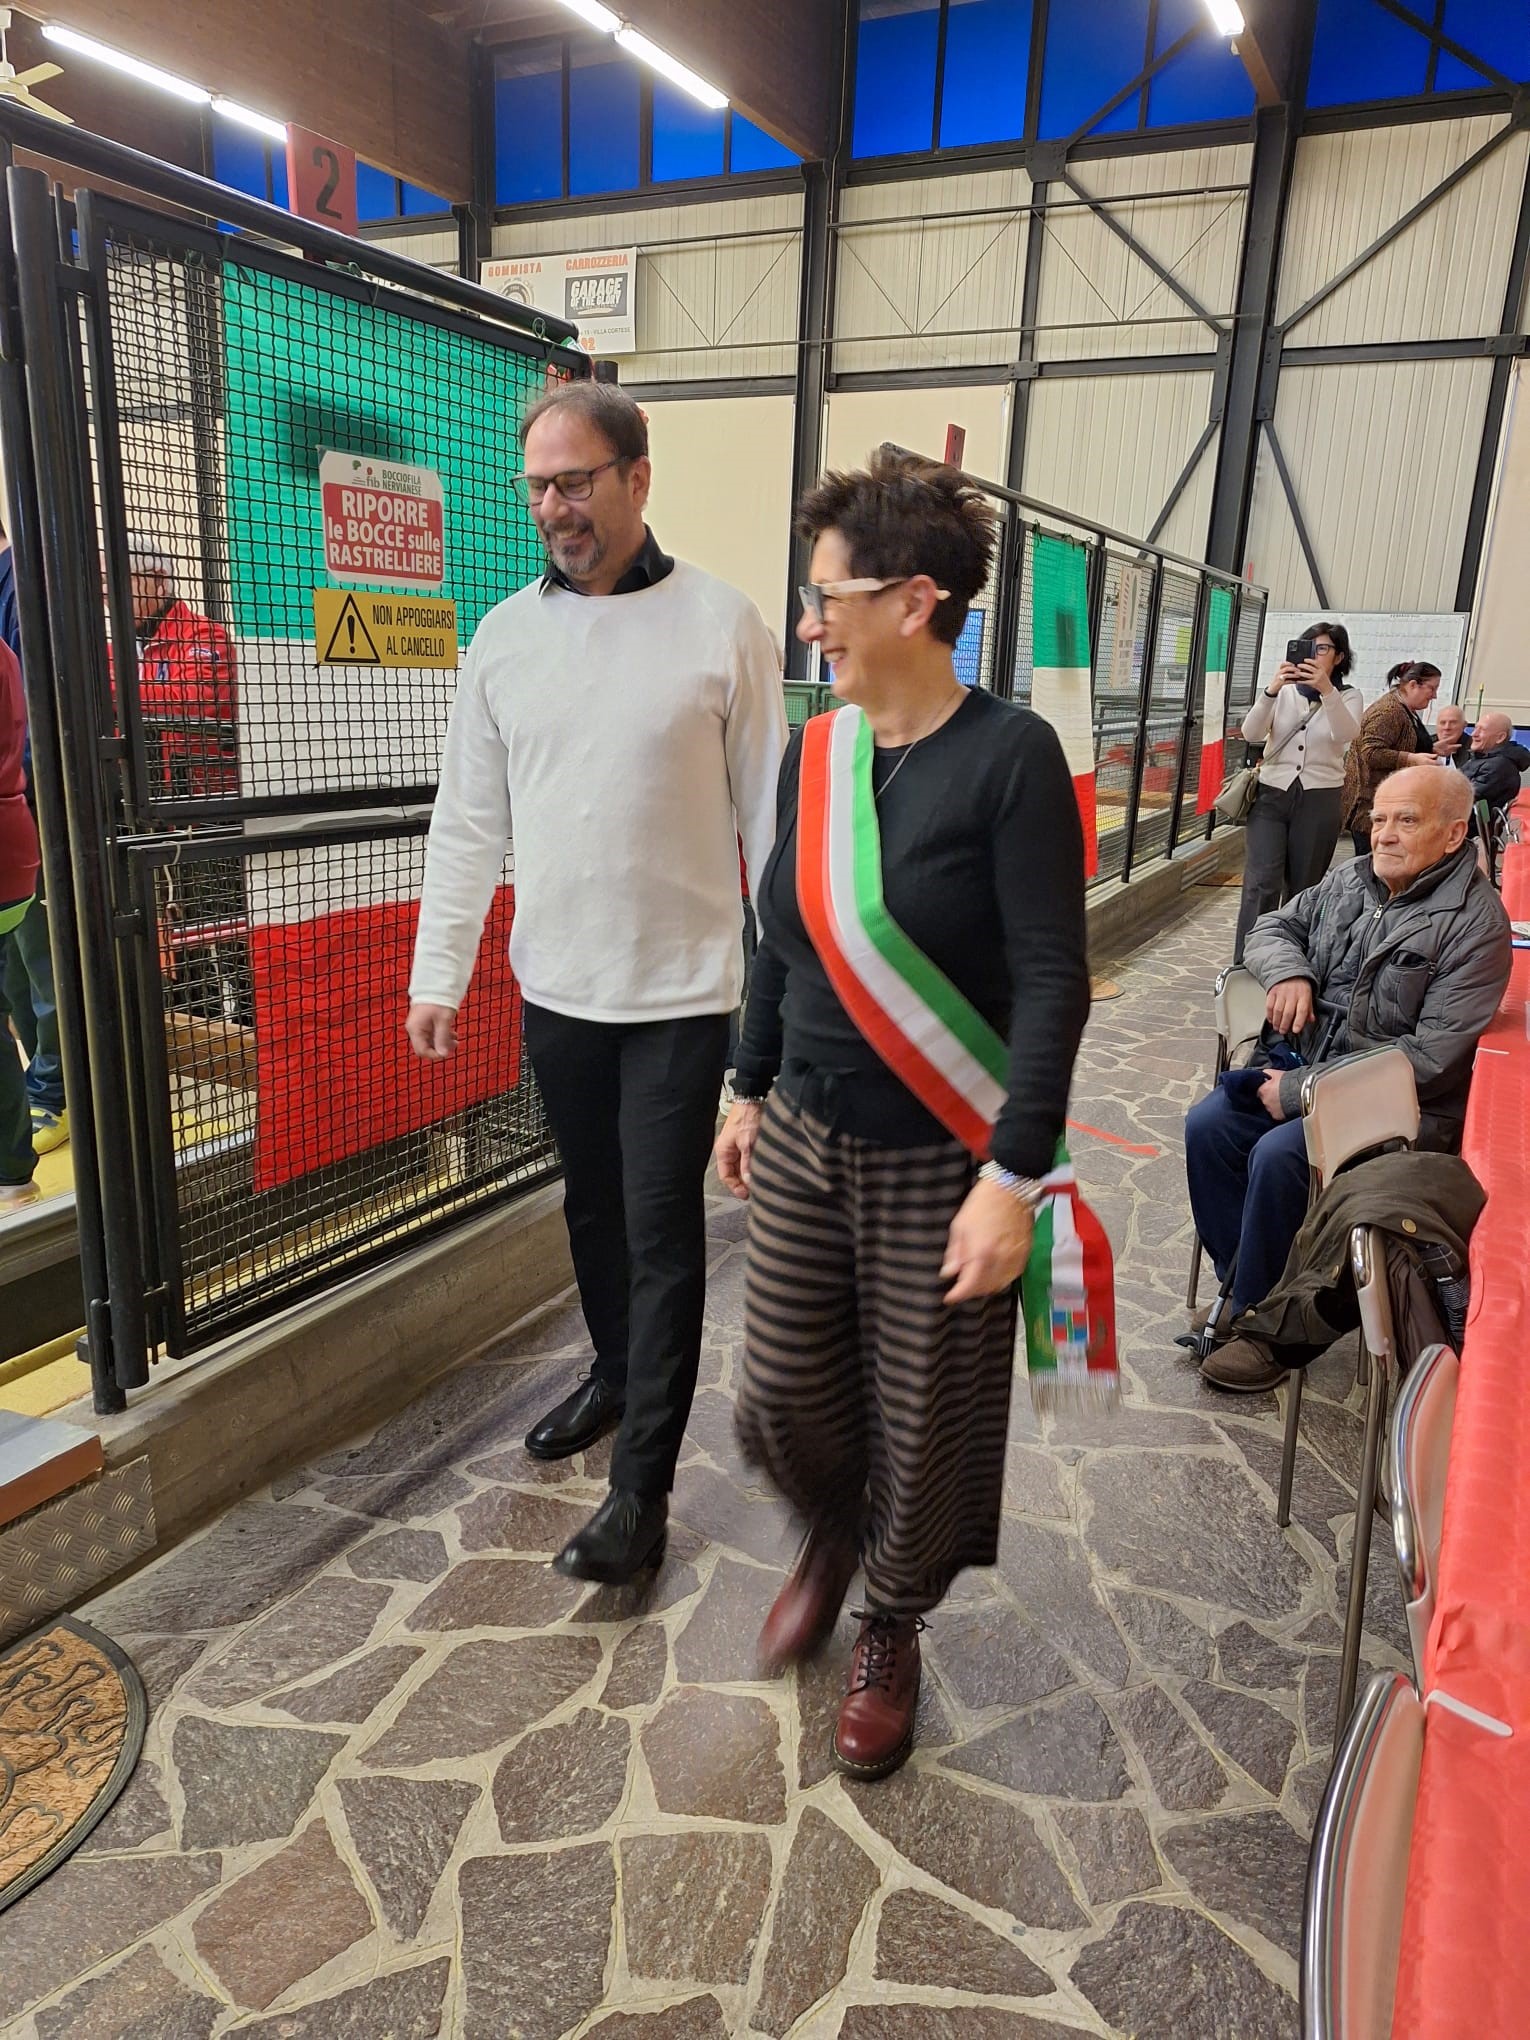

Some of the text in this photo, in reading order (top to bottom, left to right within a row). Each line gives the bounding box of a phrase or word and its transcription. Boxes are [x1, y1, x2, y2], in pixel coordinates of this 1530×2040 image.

[312, 146, 343, 220] 2
[488, 262, 542, 277] GOMMISTA
[565, 254, 629, 271] CARROZZERIA
[570, 277, 623, 299] GARAGE
[570, 297, 581, 308] OF
[581, 295, 595, 307] THE
[596, 291, 622, 305] GLORY
[607, 327, 631, 335] CORTESE
[366, 476, 380, 488] fib
[382, 469, 422, 485] BOCCIOFILA
[382, 479, 422, 496] NERVIANESE
[341, 489, 429, 529] RIPORRE
[328, 517, 441, 552] le BOCCE sulle
[329, 543, 441, 576] RASTRELLIERE
[372, 604, 455, 630] NON APPOGGIARSI
[386, 635, 445, 658] AL CANCELLO
